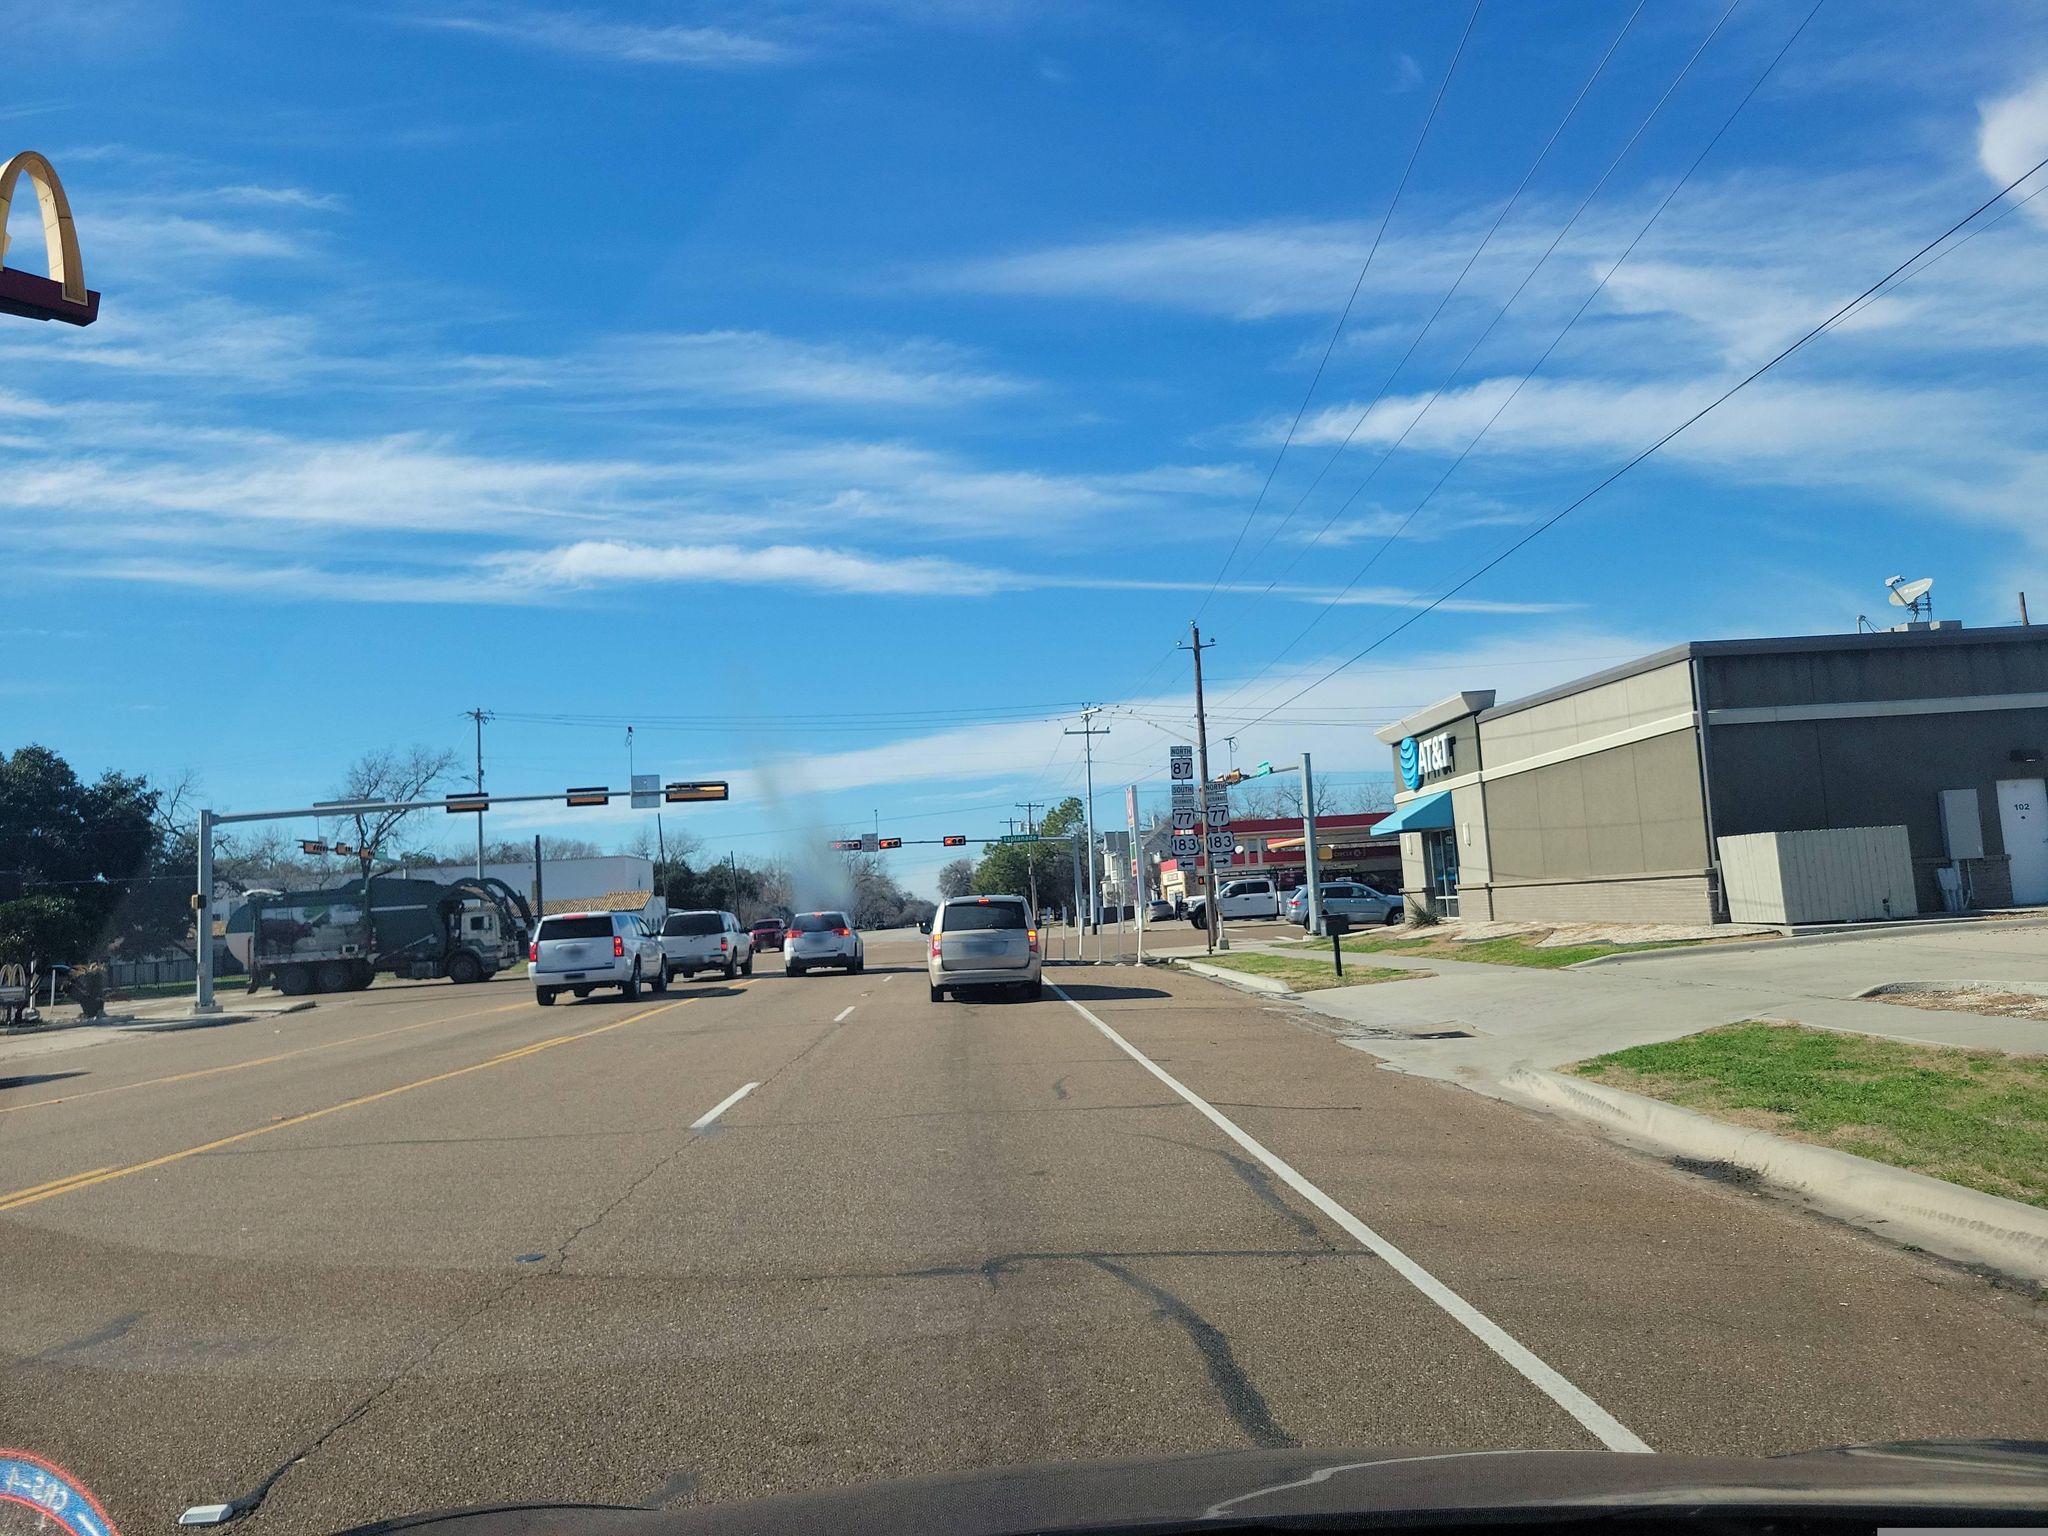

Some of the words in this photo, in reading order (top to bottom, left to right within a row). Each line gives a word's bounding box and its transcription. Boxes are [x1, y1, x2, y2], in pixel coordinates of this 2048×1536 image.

[1418, 732, 1449, 776] AT&T
[1173, 762, 1191, 775] 87
[1173, 786, 1192, 794] SOUTH
[1206, 783, 1226, 791] NORTH
[2014, 803, 2031, 811] 102
[1175, 813, 1192, 825] 77
[1209, 810, 1226, 822] 77
[1003, 835, 1037, 843] Esplanade
[1173, 839, 1196, 851] 183
[1209, 836, 1232, 848] 183
